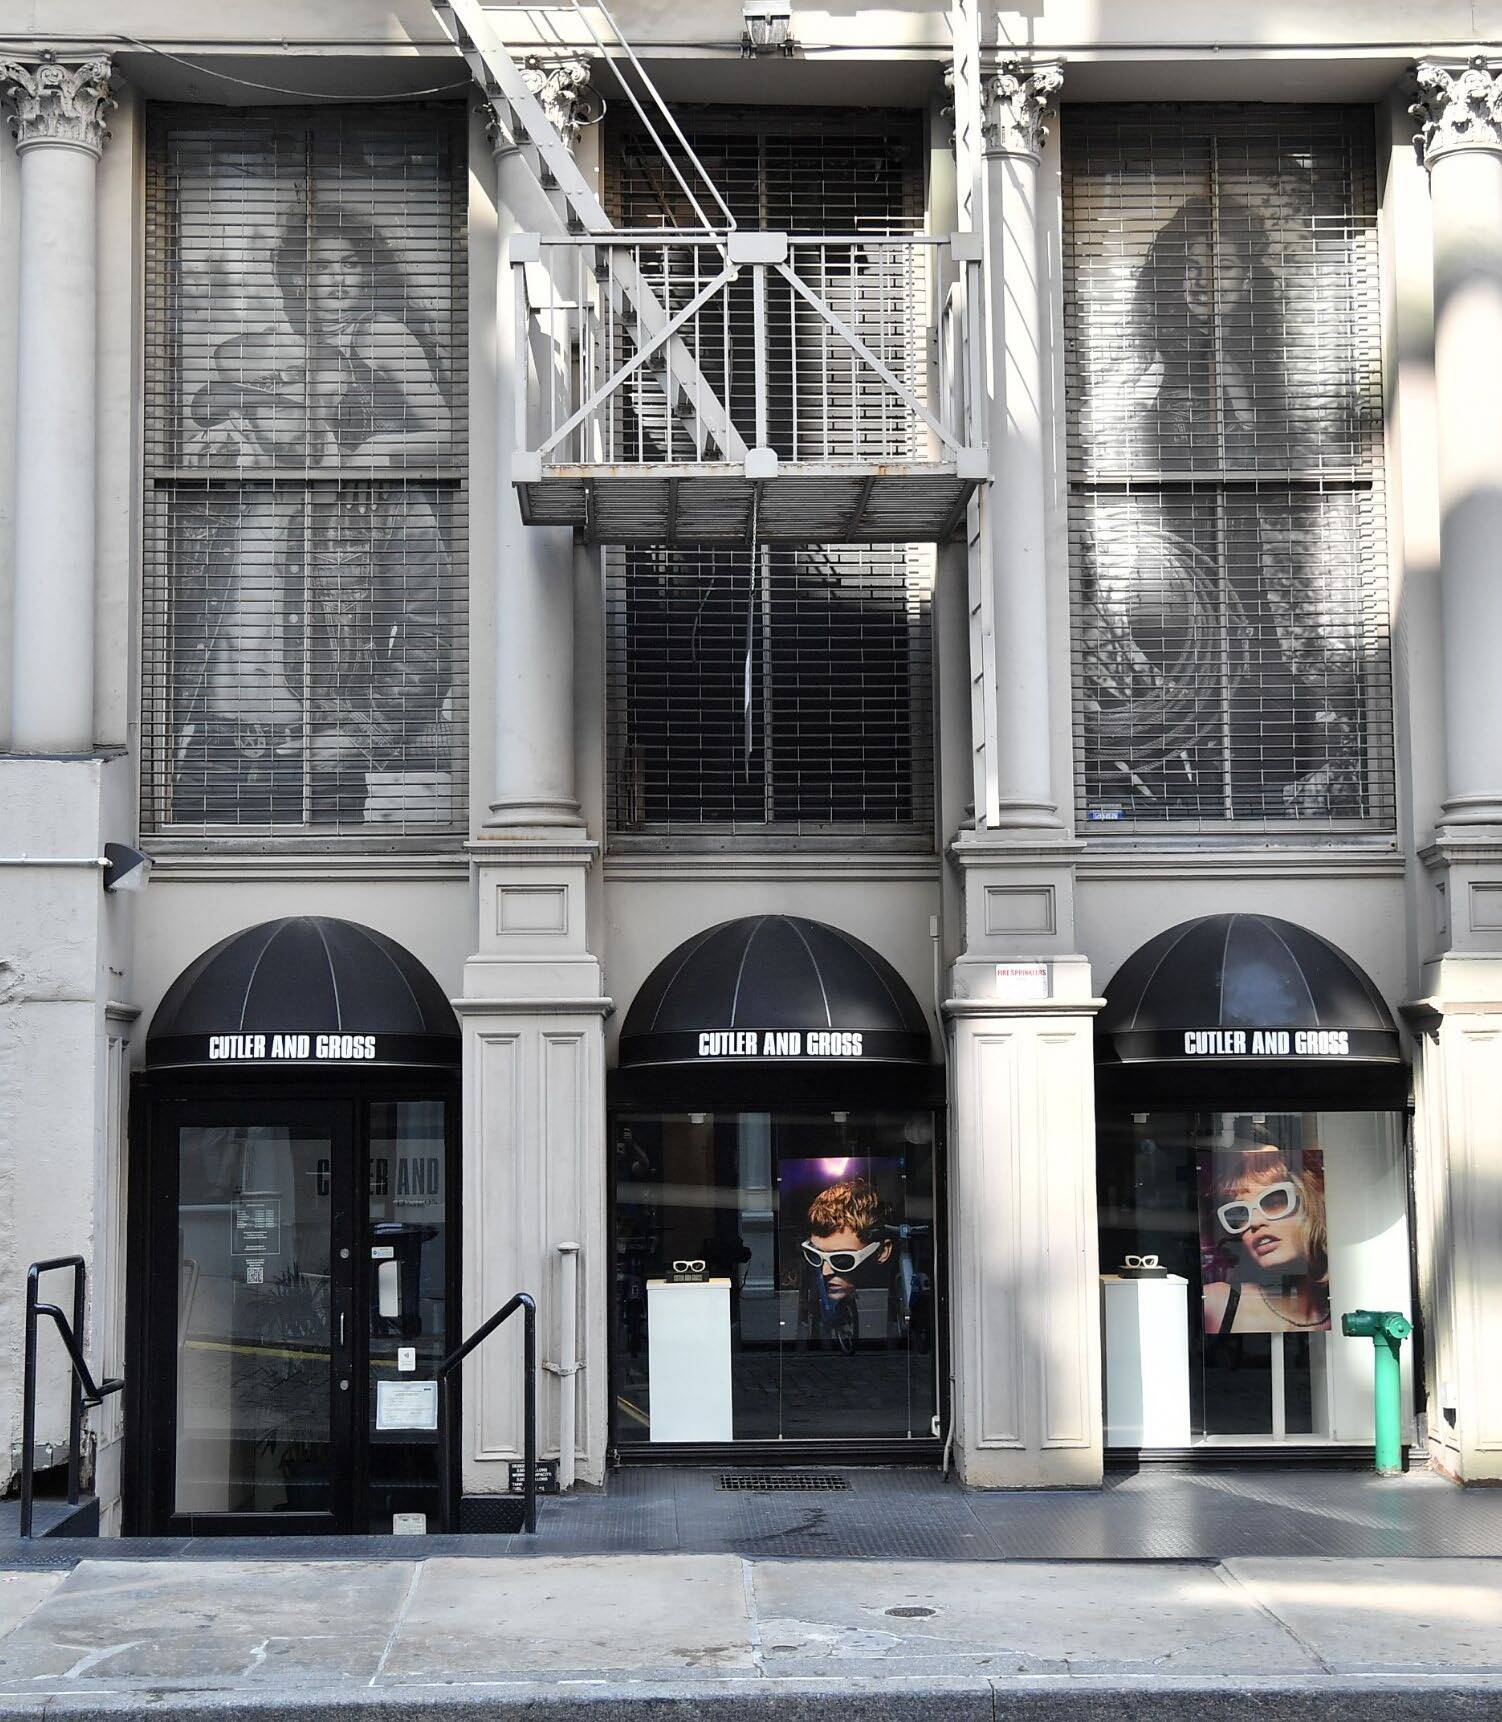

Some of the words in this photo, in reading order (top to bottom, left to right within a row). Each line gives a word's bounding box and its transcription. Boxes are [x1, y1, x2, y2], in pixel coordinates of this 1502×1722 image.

[997, 968, 1009, 976] FIRE
[209, 1035, 266, 1059] CUTLER
[271, 1035, 310, 1059] AND
[315, 1035, 376, 1060] GROSS
[698, 1032, 758, 1056] CUTLER
[763, 1032, 801, 1056] AND
[806, 1032, 863, 1056] GROSS
[1184, 1031, 1246, 1055] CUTLER
[1251, 1031, 1290, 1055] AND
[1294, 1031, 1349, 1055] GROSS
[396, 1157, 440, 1196] AND
